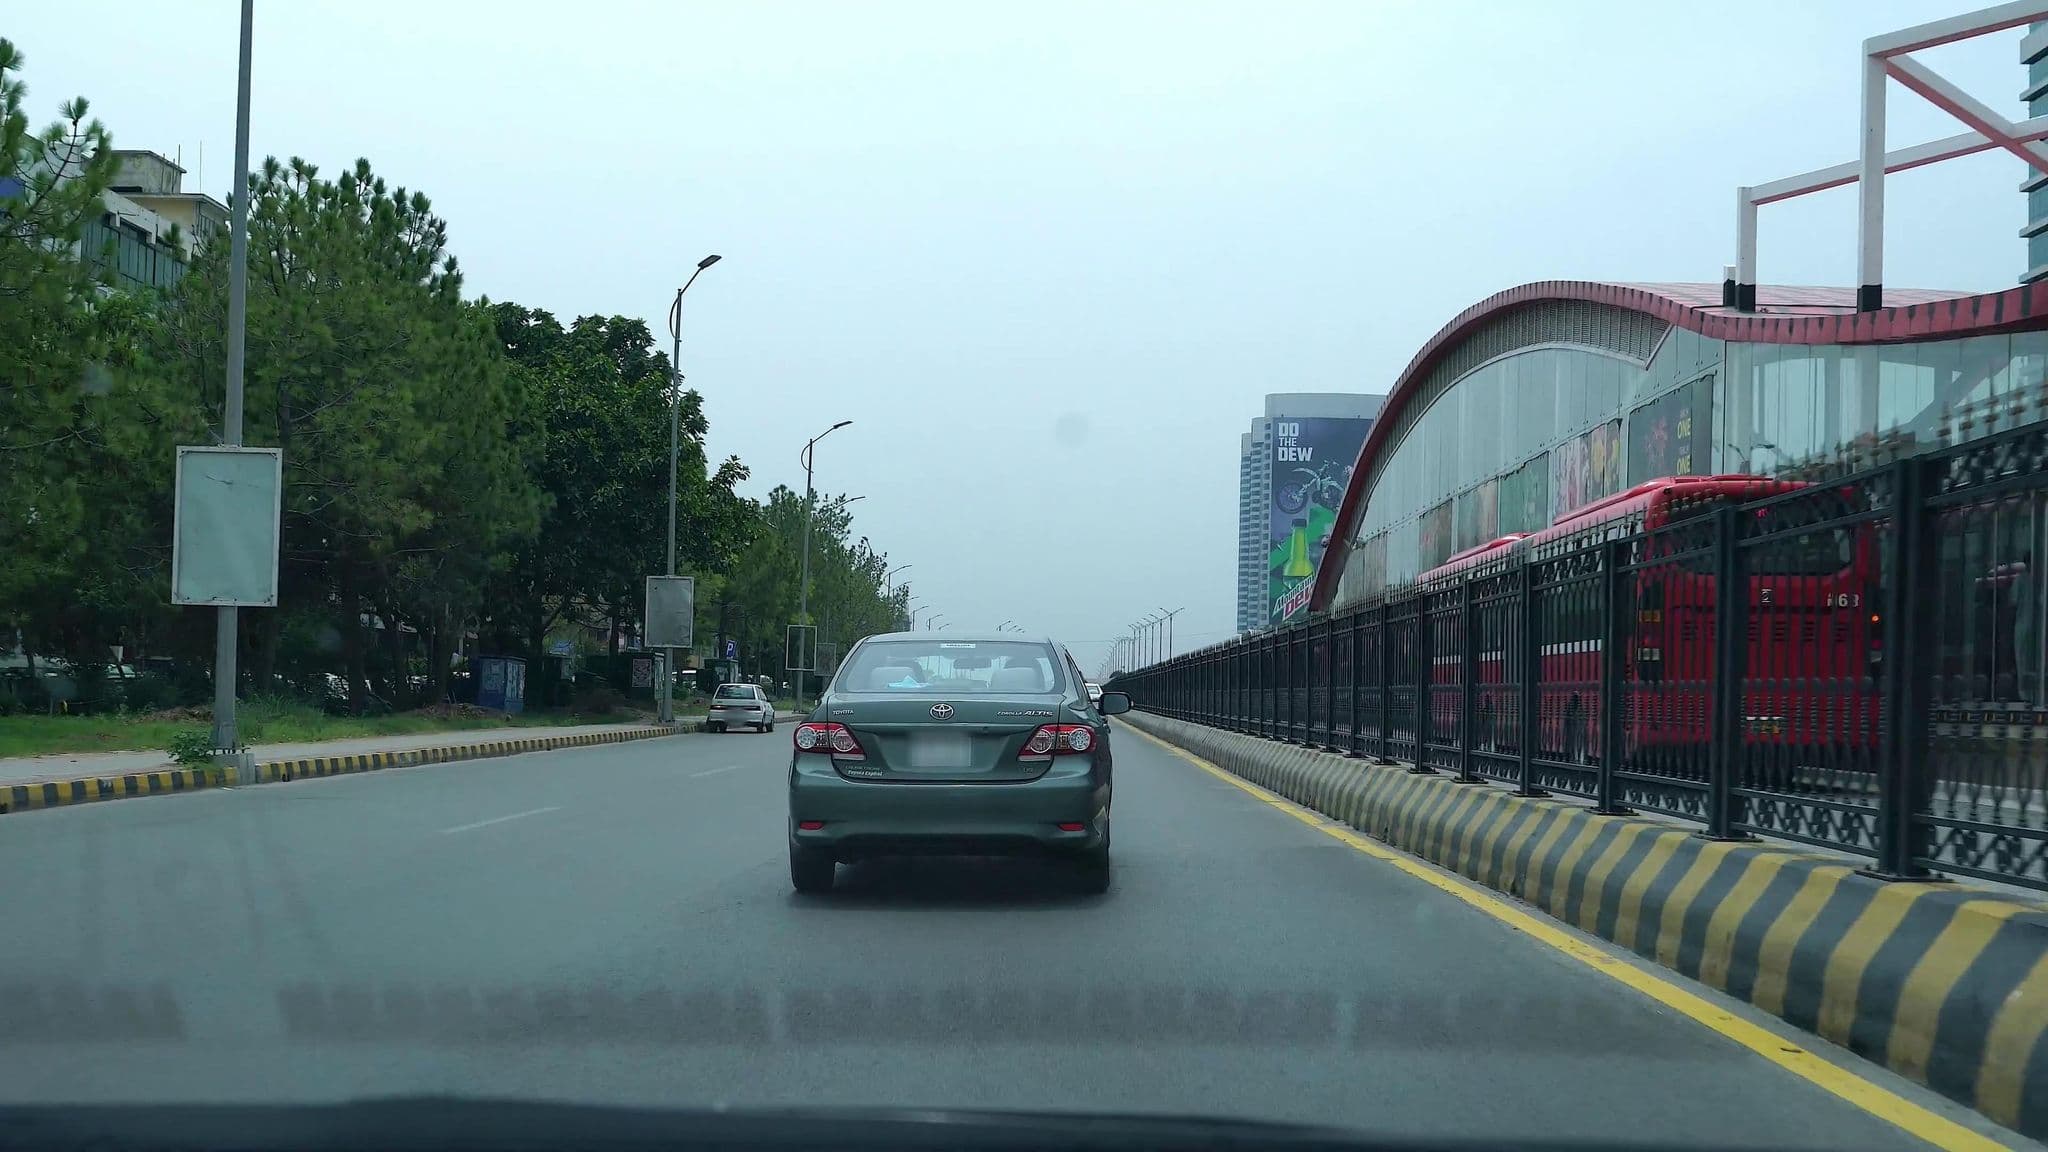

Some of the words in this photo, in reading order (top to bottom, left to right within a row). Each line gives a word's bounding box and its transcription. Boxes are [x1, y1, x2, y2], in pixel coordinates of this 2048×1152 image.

[1278, 422, 1299, 437] DO
[1678, 418, 1691, 439] ONE
[1279, 437, 1297, 447] THE
[1278, 446, 1313, 462] DEW
[1677, 454, 1691, 475] ONE
[726, 642, 734, 656] P
